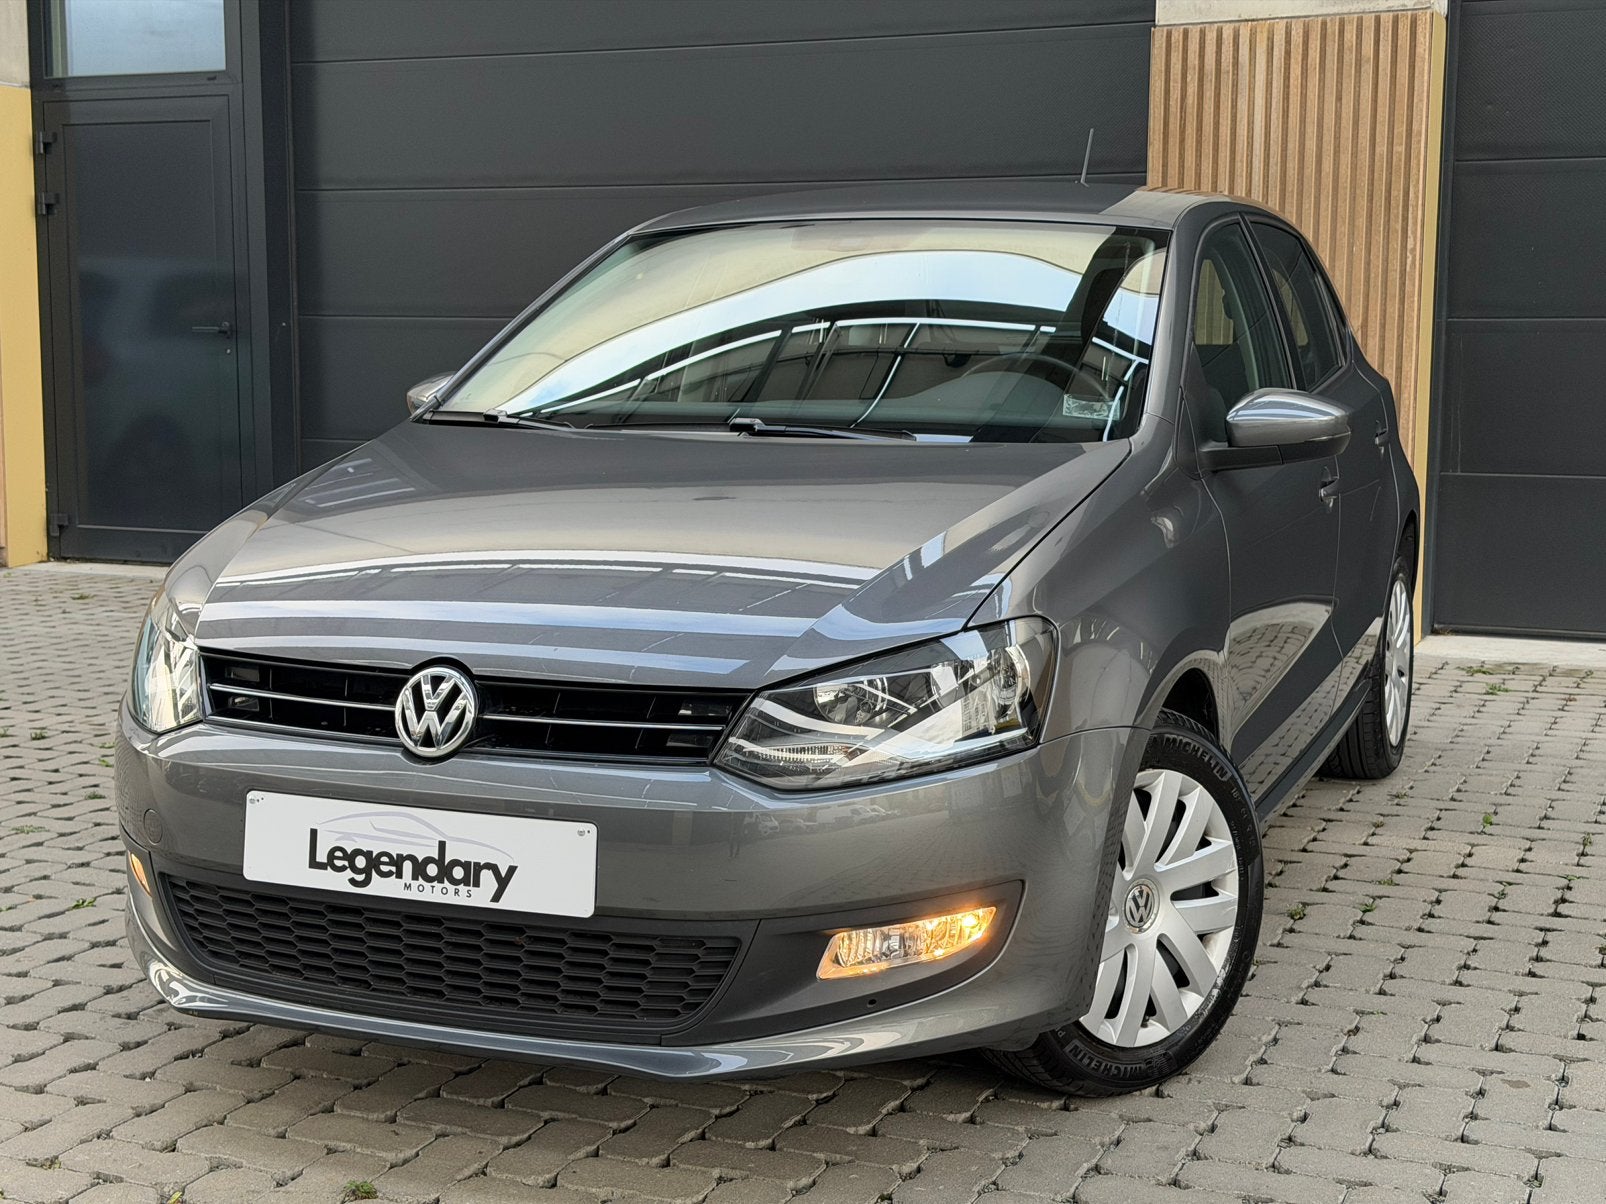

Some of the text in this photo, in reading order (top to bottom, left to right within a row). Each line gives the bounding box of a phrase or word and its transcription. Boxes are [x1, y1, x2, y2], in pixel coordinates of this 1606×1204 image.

[399, 670, 471, 752] VW
[1163, 734, 1229, 781] MICHELIN
[308, 828, 518, 903] Legendary
[403, 882, 472, 898] MOTORS
[1125, 886, 1153, 926] VW
[1068, 1043, 1143, 1079] MICHELIN
